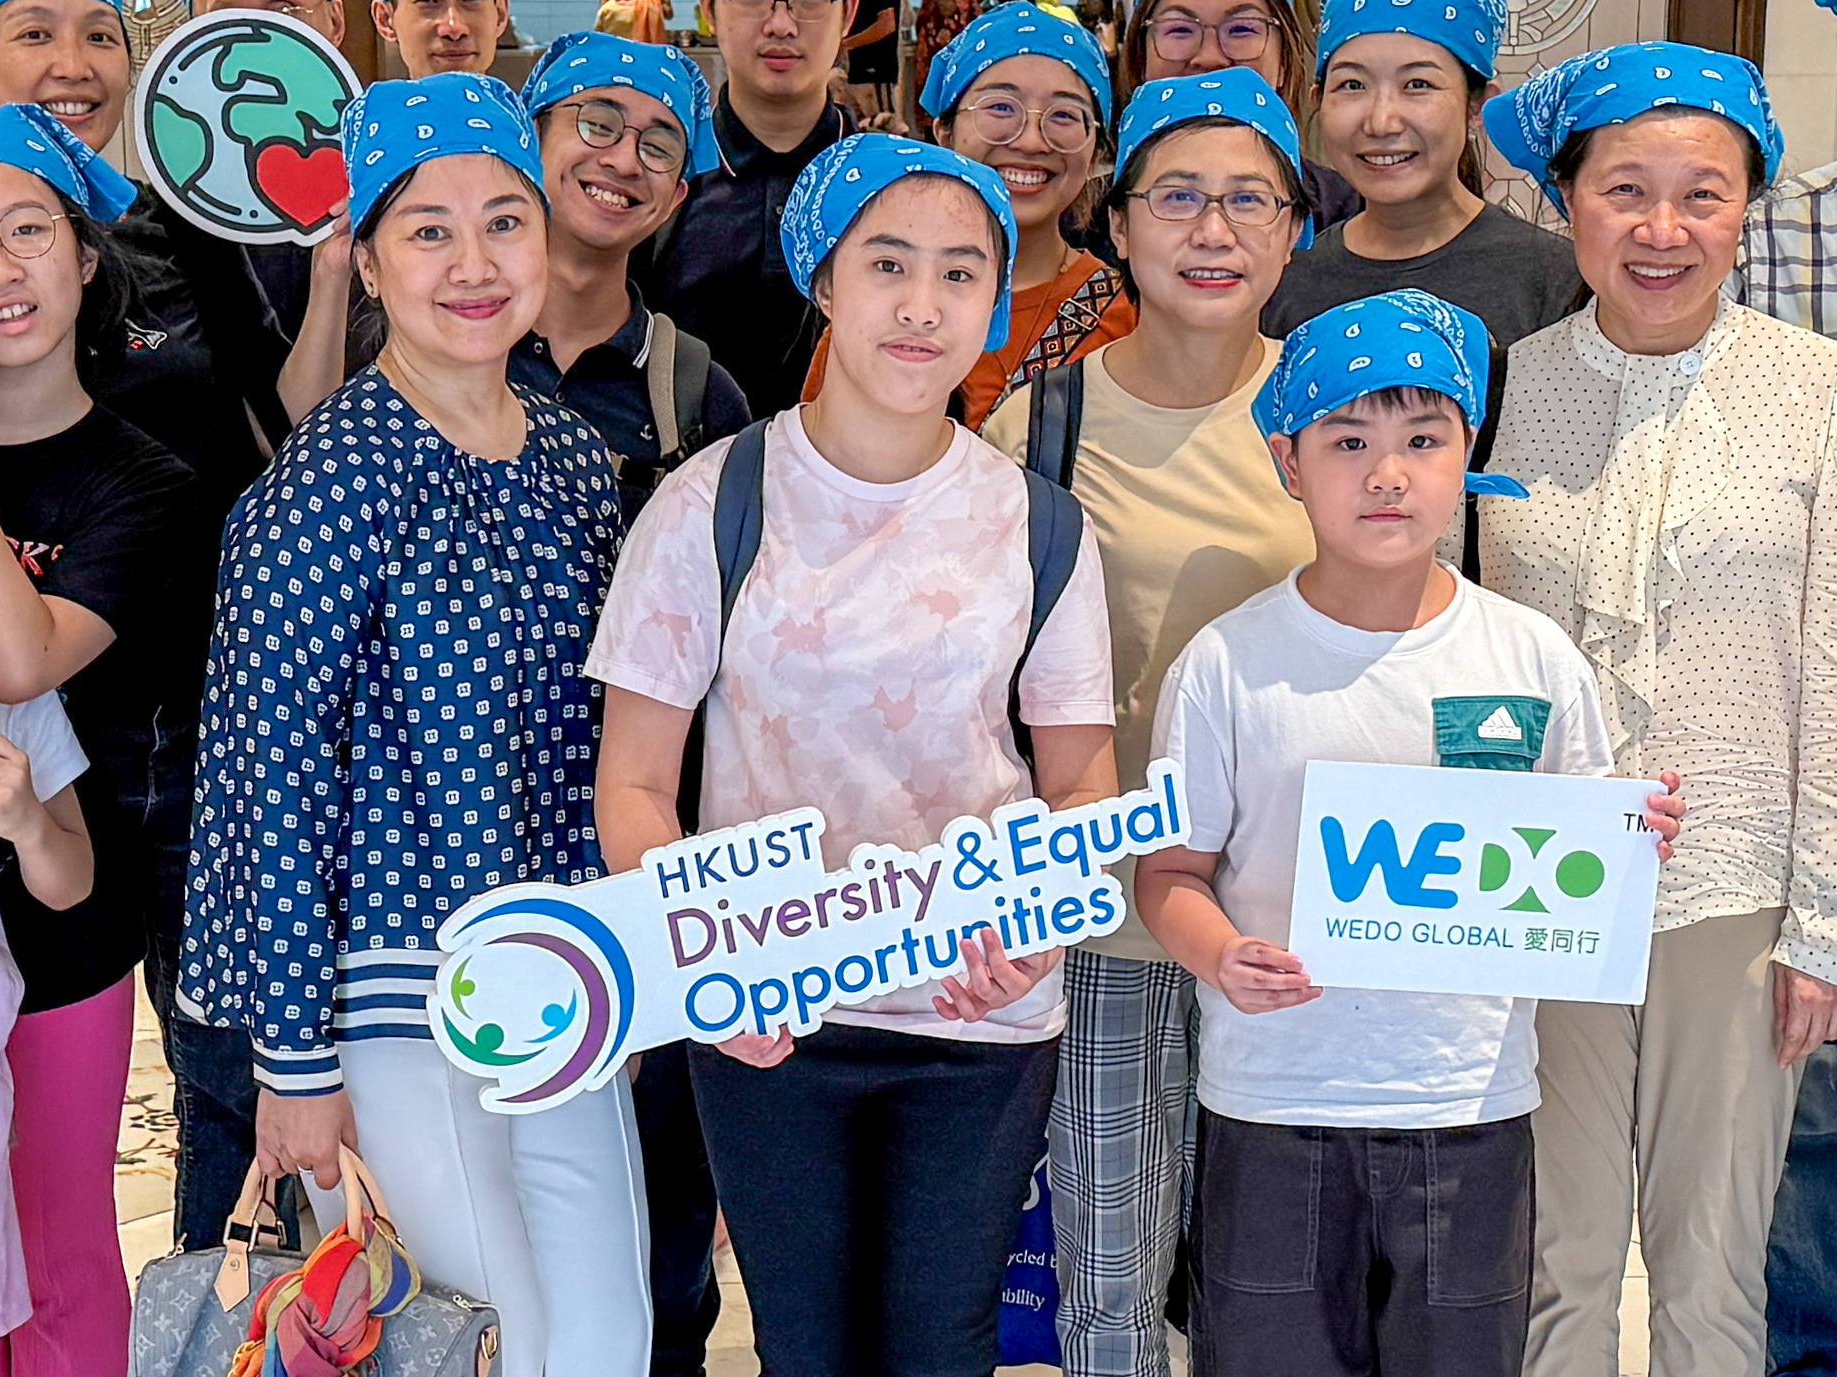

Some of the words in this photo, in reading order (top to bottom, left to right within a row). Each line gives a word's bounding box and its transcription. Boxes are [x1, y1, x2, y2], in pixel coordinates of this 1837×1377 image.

[658, 822, 814, 899] HKUST
[666, 858, 943, 968] Diversity
[952, 830, 1004, 890] &
[1009, 773, 1181, 880] Equal
[1326, 917, 1402, 942] WEDO
[1412, 922, 1514, 949] GLOBAL
[1524, 927, 1602, 955] 愛同行
[1007, 1249, 1046, 1267] ycled
